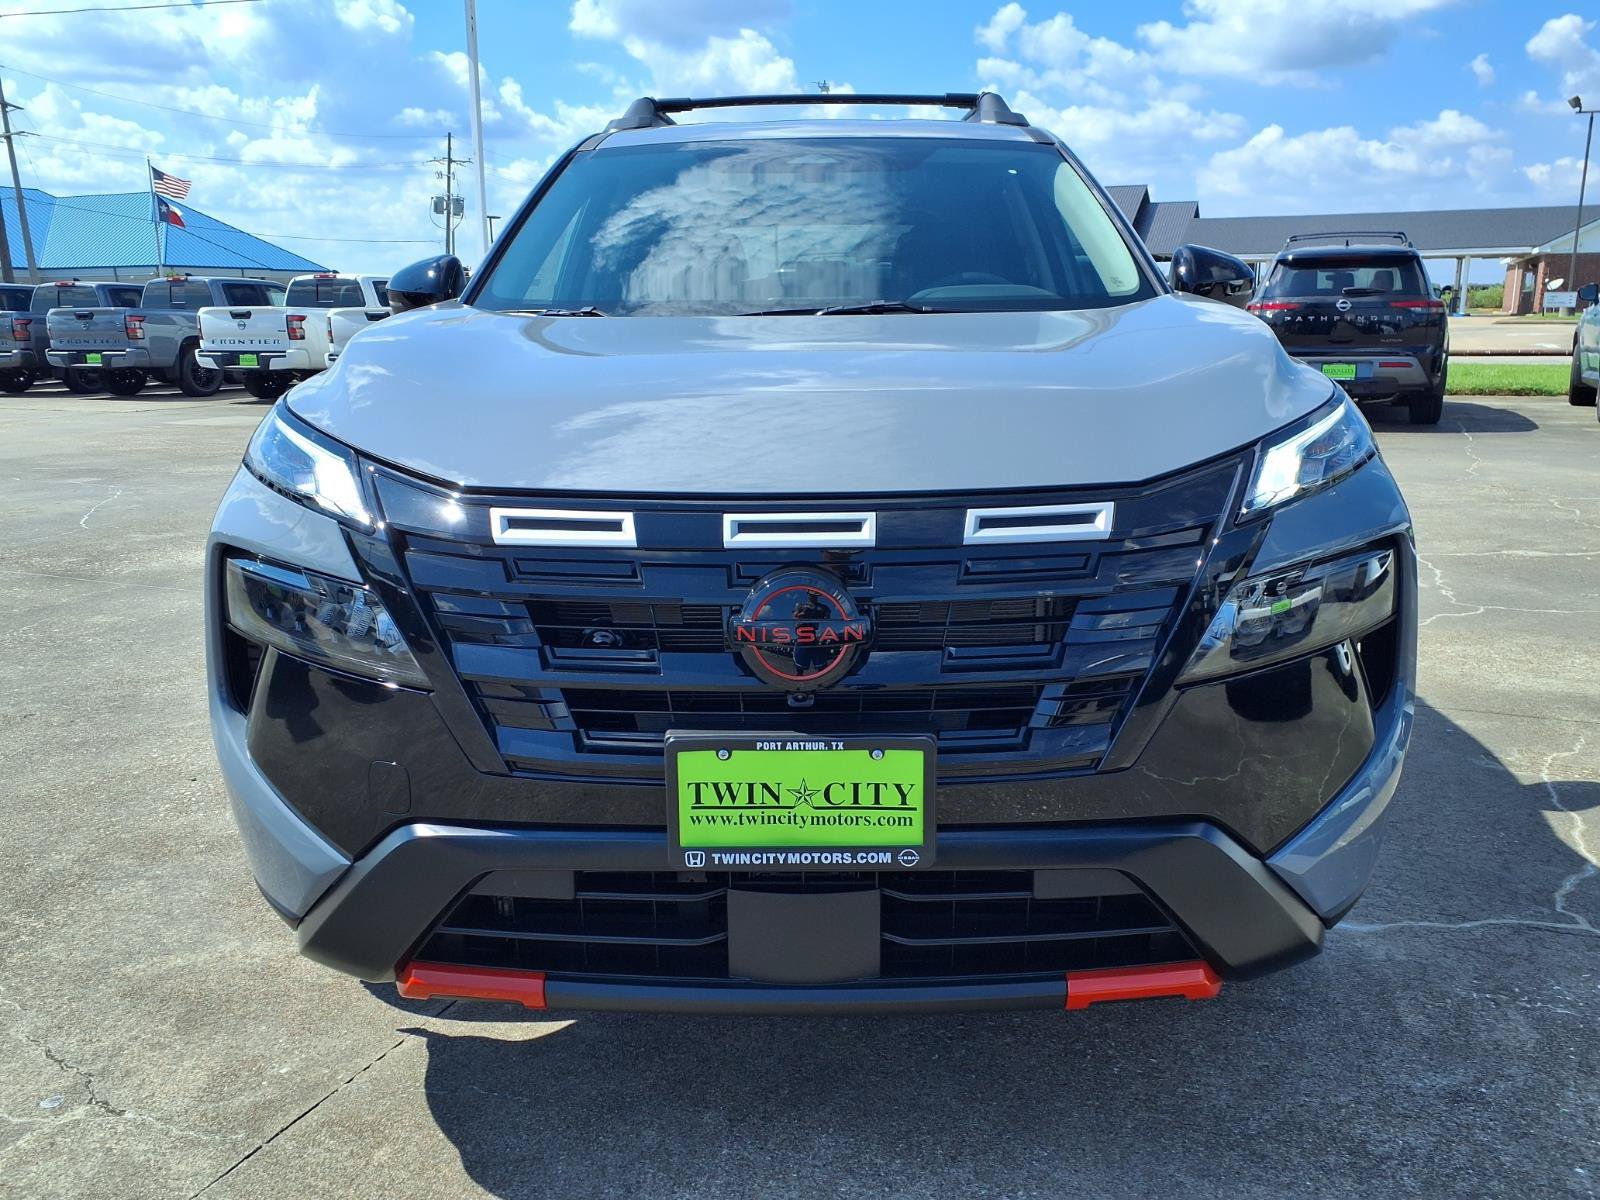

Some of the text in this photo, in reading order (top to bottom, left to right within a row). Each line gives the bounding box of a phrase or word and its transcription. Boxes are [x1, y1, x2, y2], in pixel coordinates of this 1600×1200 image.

[737, 624, 864, 643] NISSAN
[756, 741, 782, 750] PORT
[831, 741, 844, 750] TX
[687, 782, 916, 806] TWIN CITY
[690, 811, 914, 829] www.twincitymotors.com
[711, 852, 892, 865] TWINCITYMOTORS.COM
